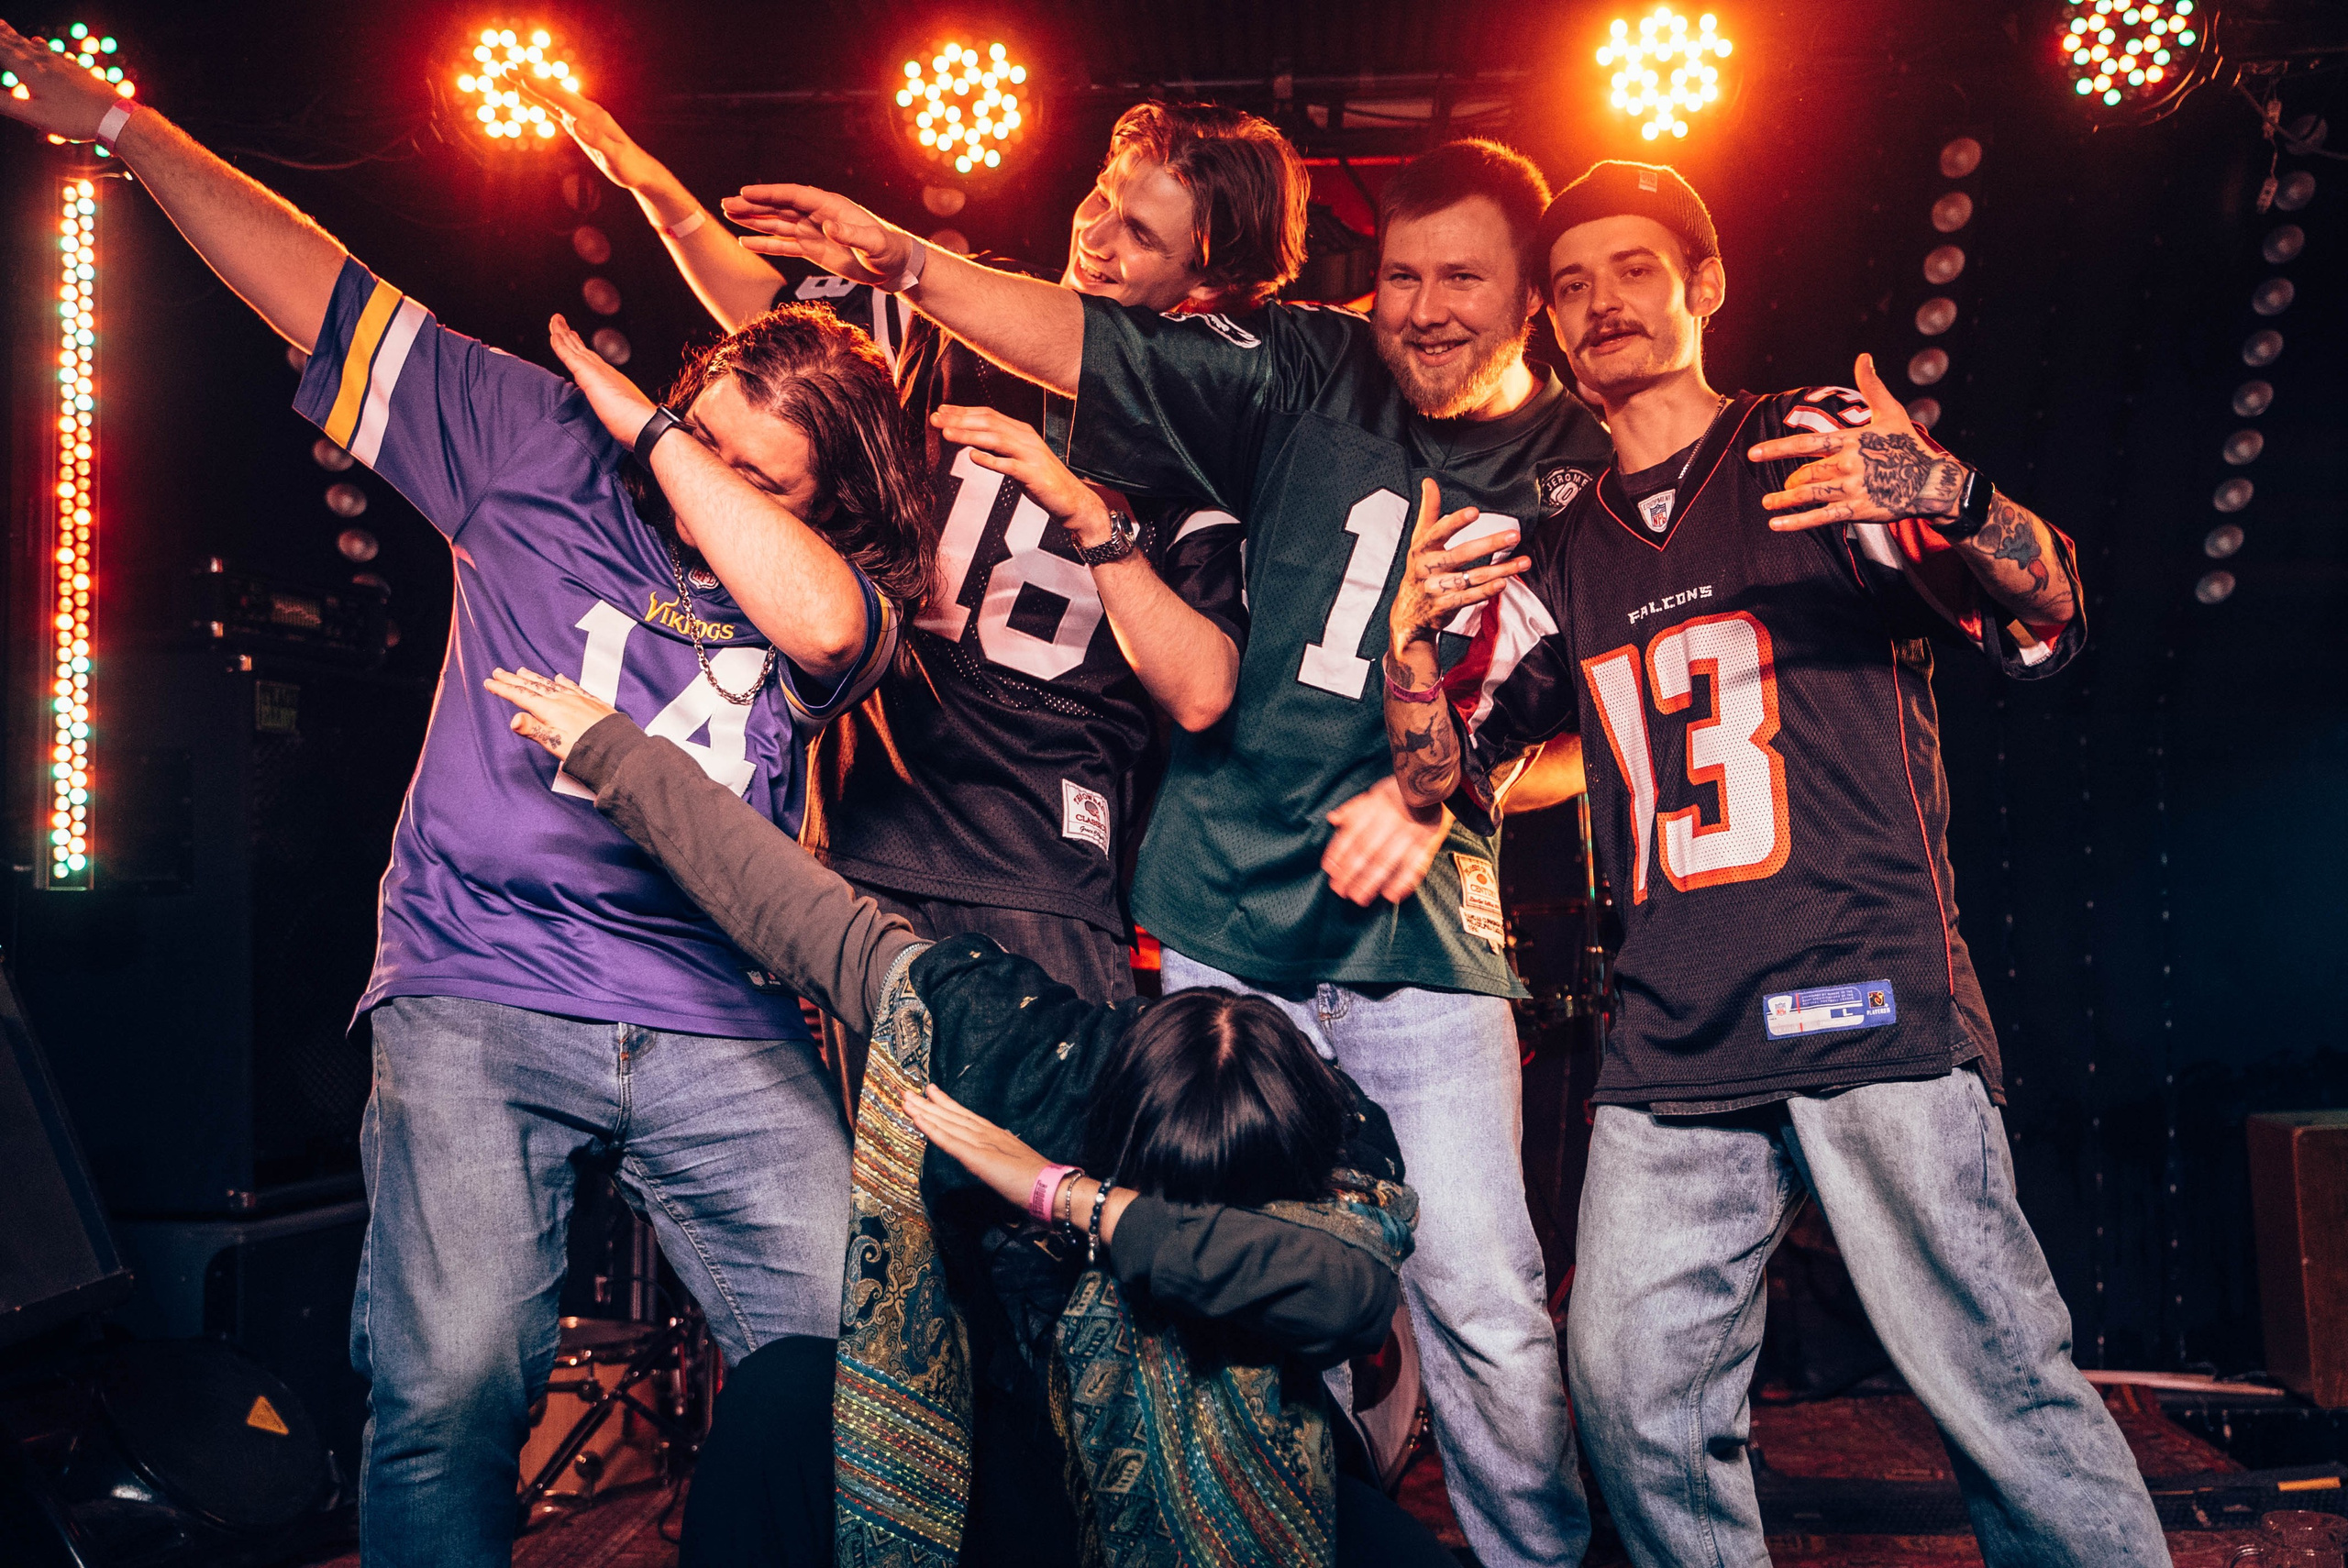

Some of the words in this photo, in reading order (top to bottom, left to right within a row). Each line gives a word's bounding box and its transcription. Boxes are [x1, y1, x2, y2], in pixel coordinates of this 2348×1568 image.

[1546, 473, 1589, 491] JEROME
[1652, 513, 1667, 526] NFL
[693, 569, 717, 585] NFL
[912, 446, 1141, 682] 18
[1628, 585, 1712, 624] FALCONS
[551, 599, 769, 803] 14
[1580, 610, 1791, 906] 13
[1843, 1009, 1854, 1017] L
